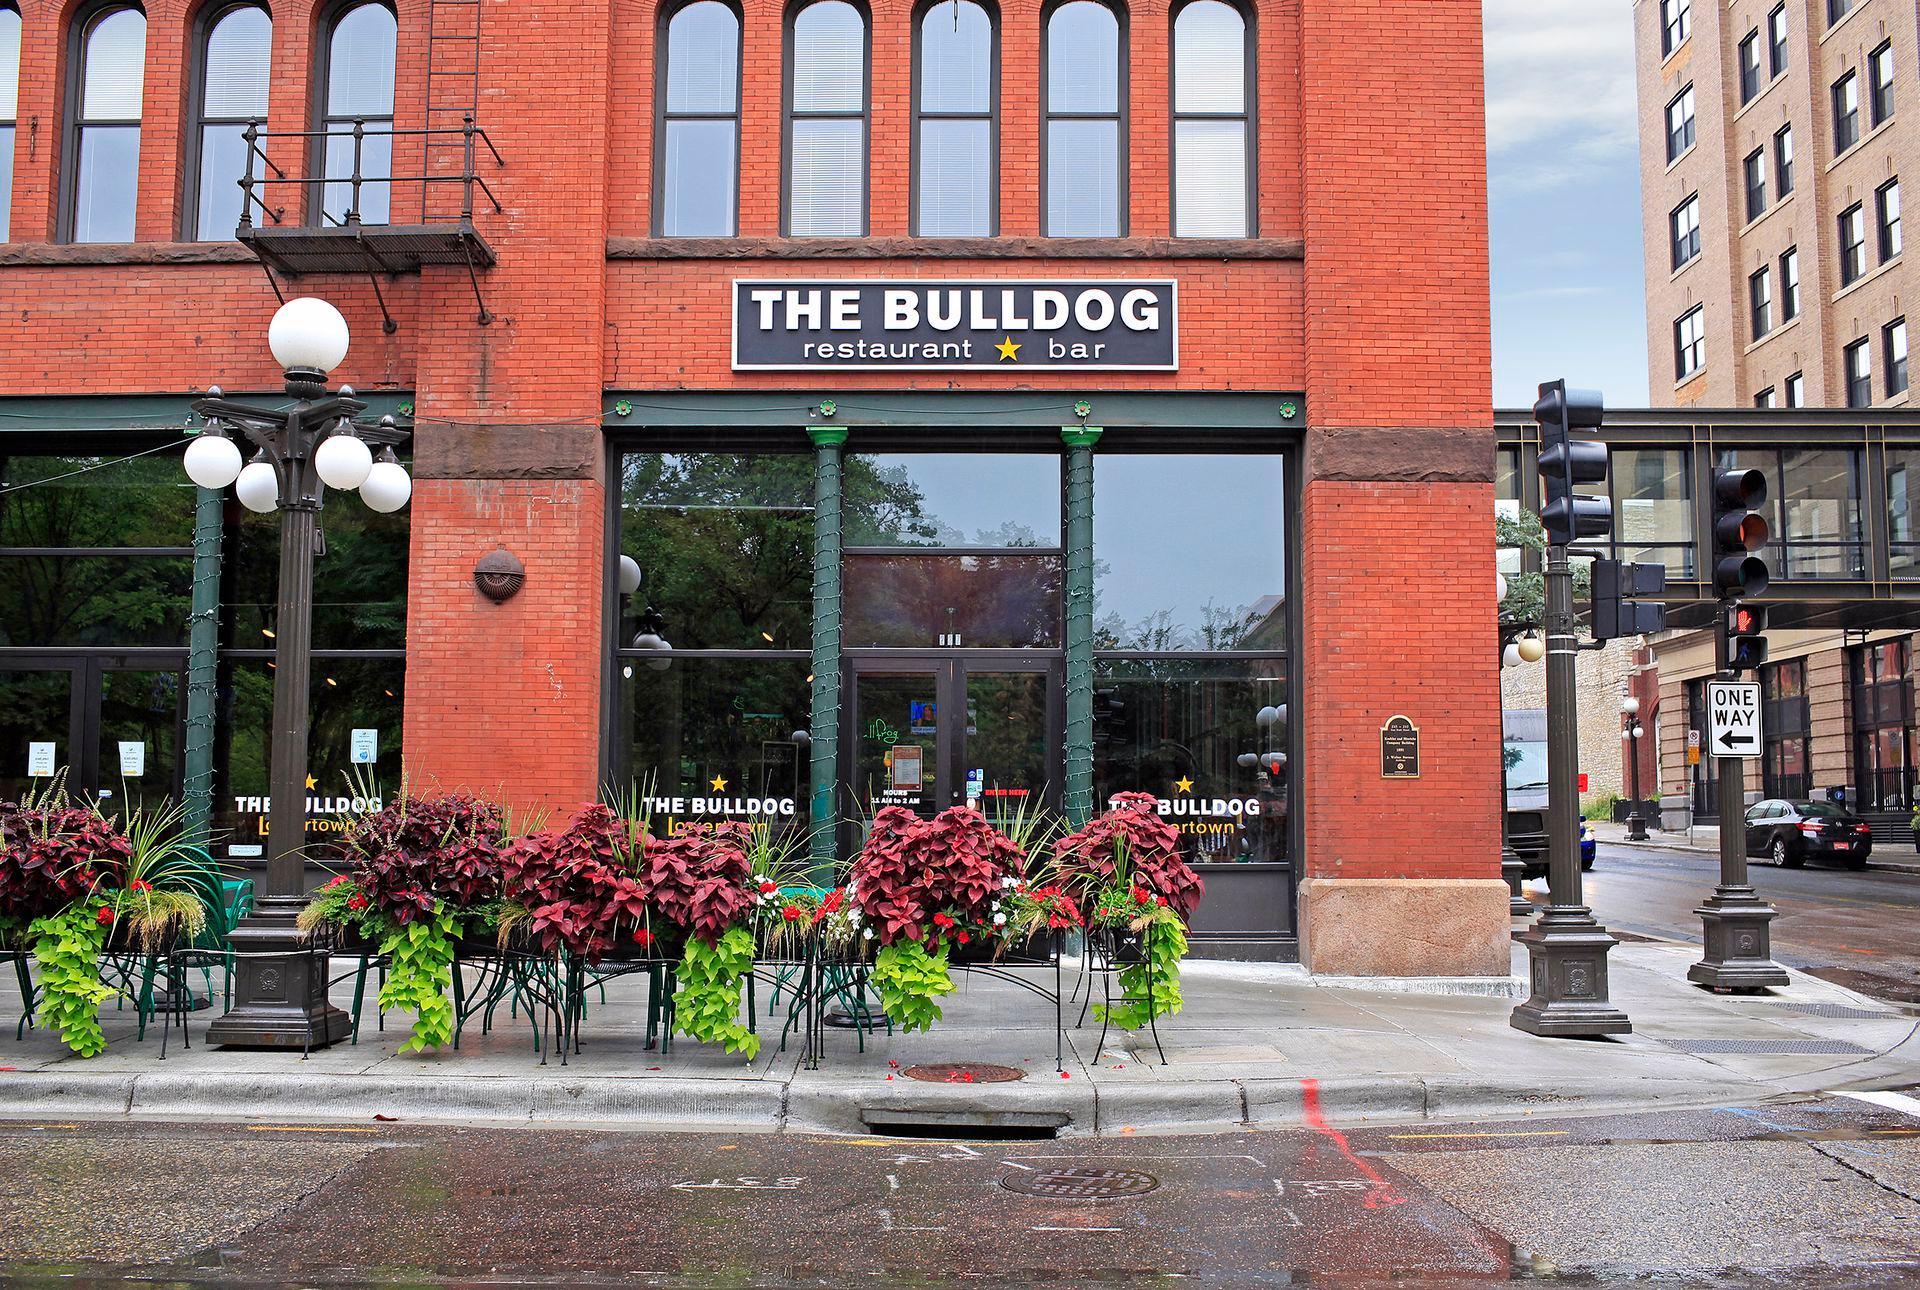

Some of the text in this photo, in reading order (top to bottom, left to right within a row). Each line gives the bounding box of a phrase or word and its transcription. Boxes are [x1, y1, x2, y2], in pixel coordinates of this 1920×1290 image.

[751, 288, 1159, 331] THE BULLDOG
[803, 336, 1106, 358] restaurant bar
[1715, 689, 1754, 706] ONE
[1715, 709, 1755, 726] WAY
[643, 797, 795, 815] THE BULLDOG
[1157, 798, 1260, 816] BULLDOG
